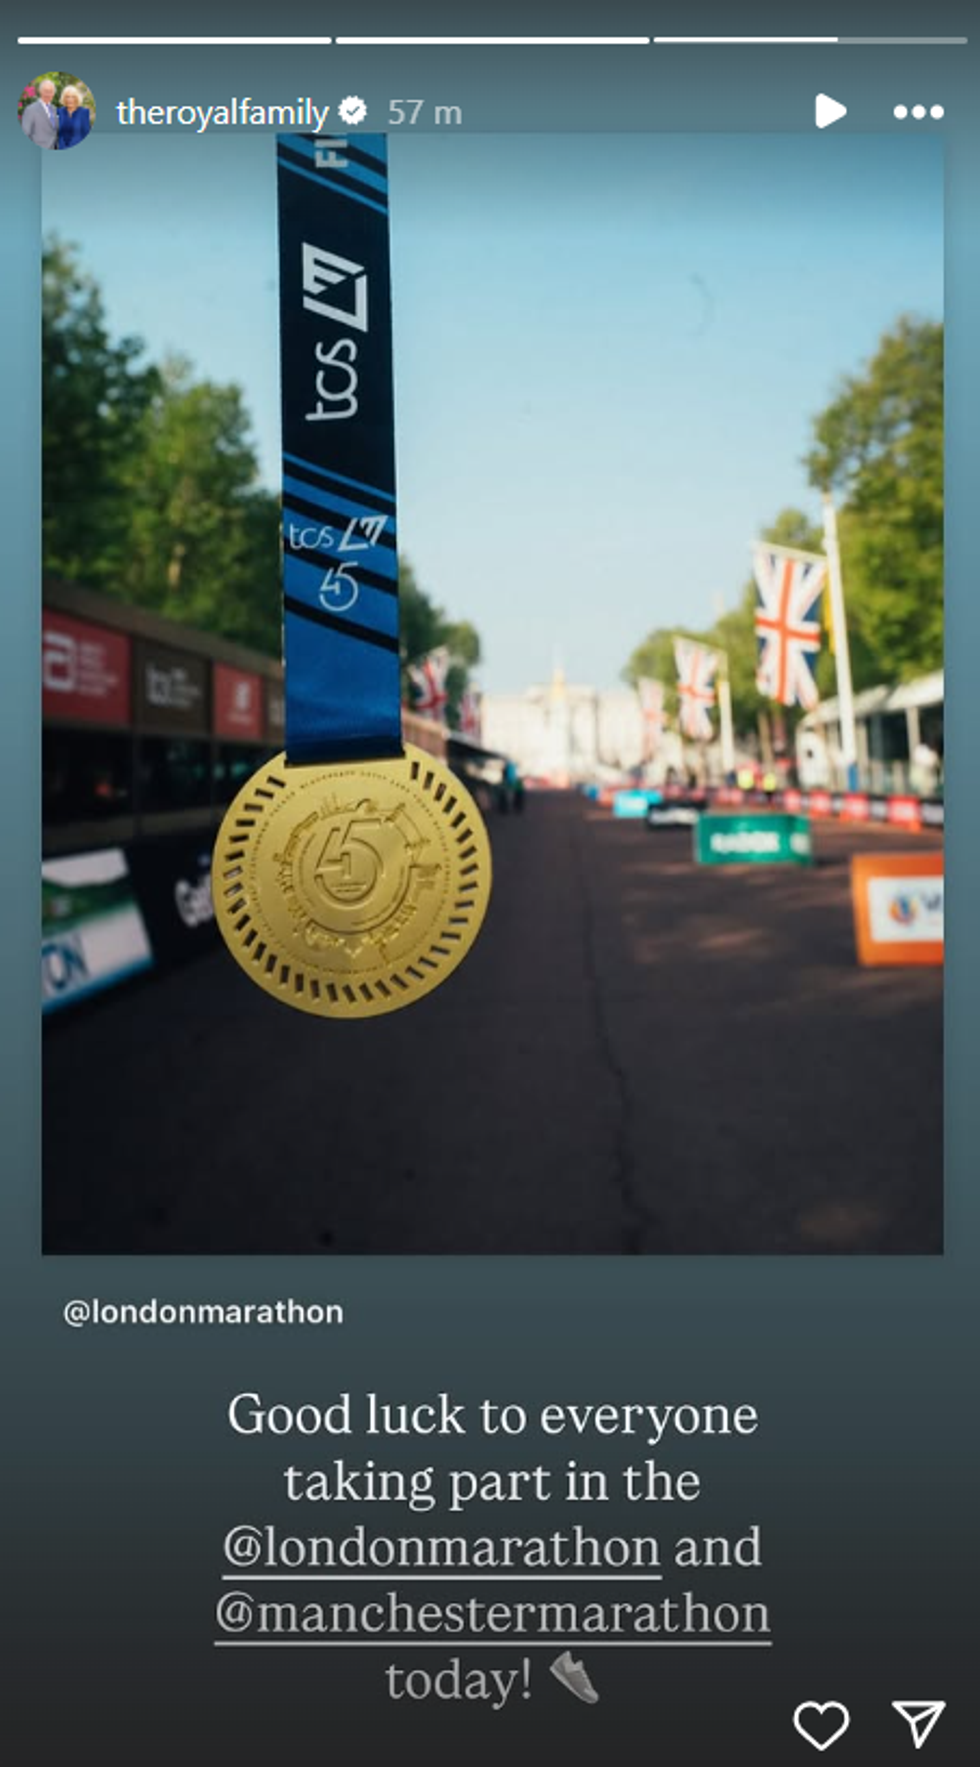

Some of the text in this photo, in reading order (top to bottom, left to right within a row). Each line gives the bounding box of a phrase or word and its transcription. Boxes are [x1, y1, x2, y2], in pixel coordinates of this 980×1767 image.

[305, 338, 358, 421] tcs
[290, 523, 334, 550] tcs
[319, 562, 359, 612] 45
